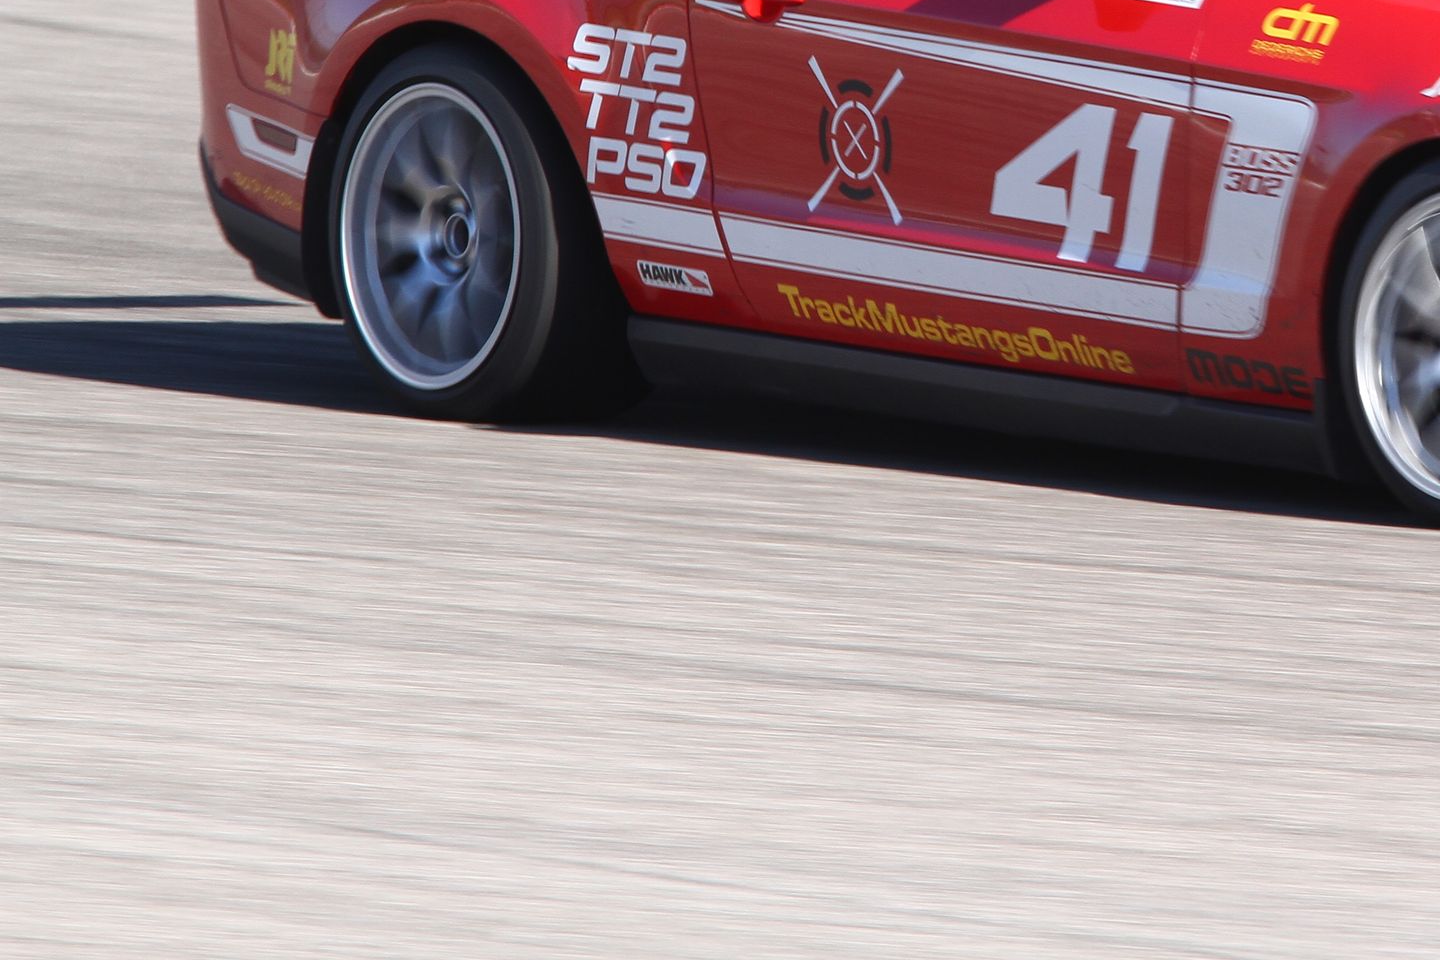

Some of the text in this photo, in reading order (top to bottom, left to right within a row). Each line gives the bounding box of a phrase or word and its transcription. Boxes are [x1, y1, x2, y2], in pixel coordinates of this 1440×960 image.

[567, 23, 687, 86] ST2
[579, 78, 695, 144] TT2
[990, 103, 1174, 272] 41
[1224, 172, 1283, 197] 302
[1225, 146, 1298, 172] BOSS
[639, 262, 687, 285] HAWK
[777, 283, 1135, 374] TrackMustangsOnline
